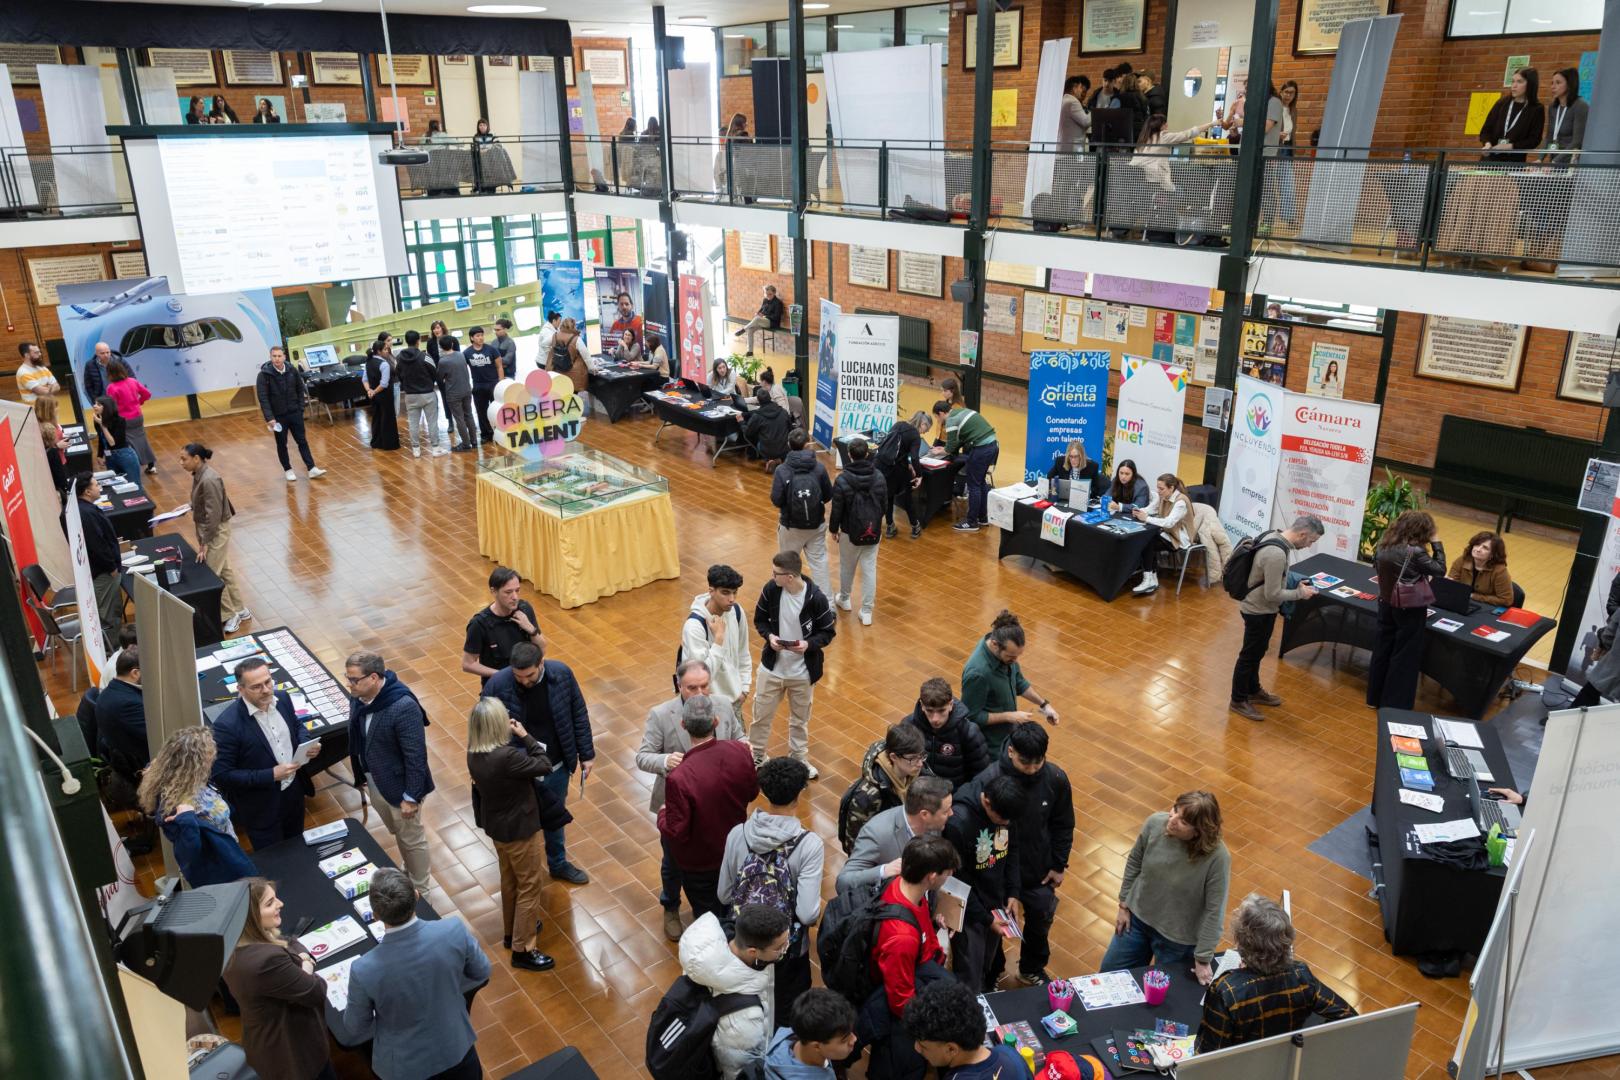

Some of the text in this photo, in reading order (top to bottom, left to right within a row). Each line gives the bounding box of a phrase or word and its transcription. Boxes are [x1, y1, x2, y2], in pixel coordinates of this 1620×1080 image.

[841, 360, 895, 376] LUCHAMOS
[841, 374, 895, 390] CONTRA LAS
[841, 387, 894, 404] ETIQUETAS
[1046, 391, 1097, 402] orienta
[502, 396, 581, 426] RIBERA
[873, 403, 882, 414] EN
[1045, 415, 1088, 425] Conectando
[1119, 418, 1143, 432] ami
[507, 420, 579, 448] TALENT
[1049, 427, 1083, 436] empresas
[1118, 431, 1143, 445] met
[1241, 485, 1267, 505] empresa
[1258, 509, 1265, 518] de
[1235, 511, 1263, 533] inserción
